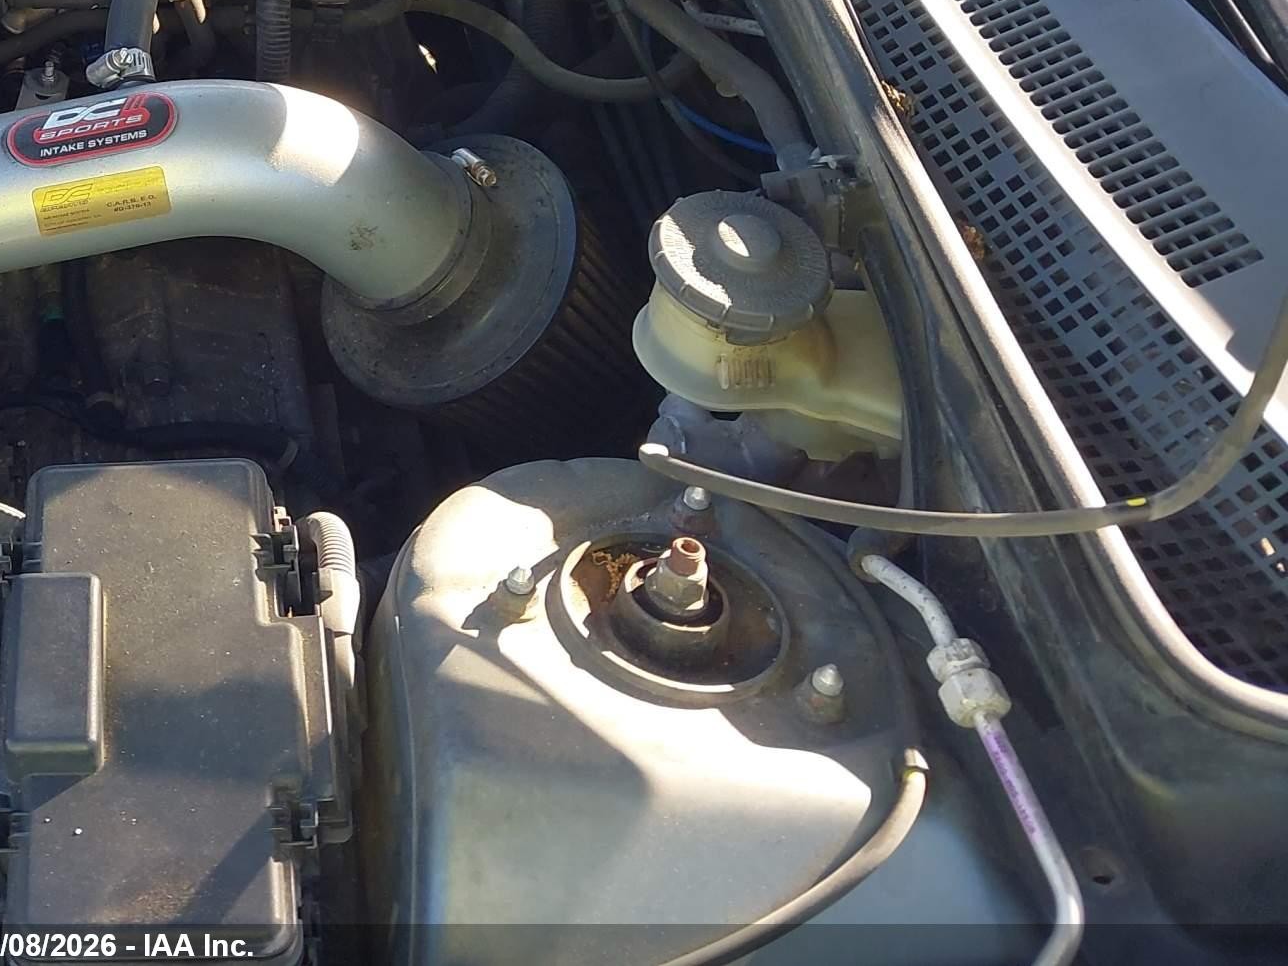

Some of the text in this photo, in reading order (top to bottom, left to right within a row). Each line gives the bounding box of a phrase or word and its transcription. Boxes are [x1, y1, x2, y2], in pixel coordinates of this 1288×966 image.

[39, 113, 143, 141] SPORTS
[43, 97, 127, 129] DC
[40, 129, 147, 157] INTAKE SYSTEMS
